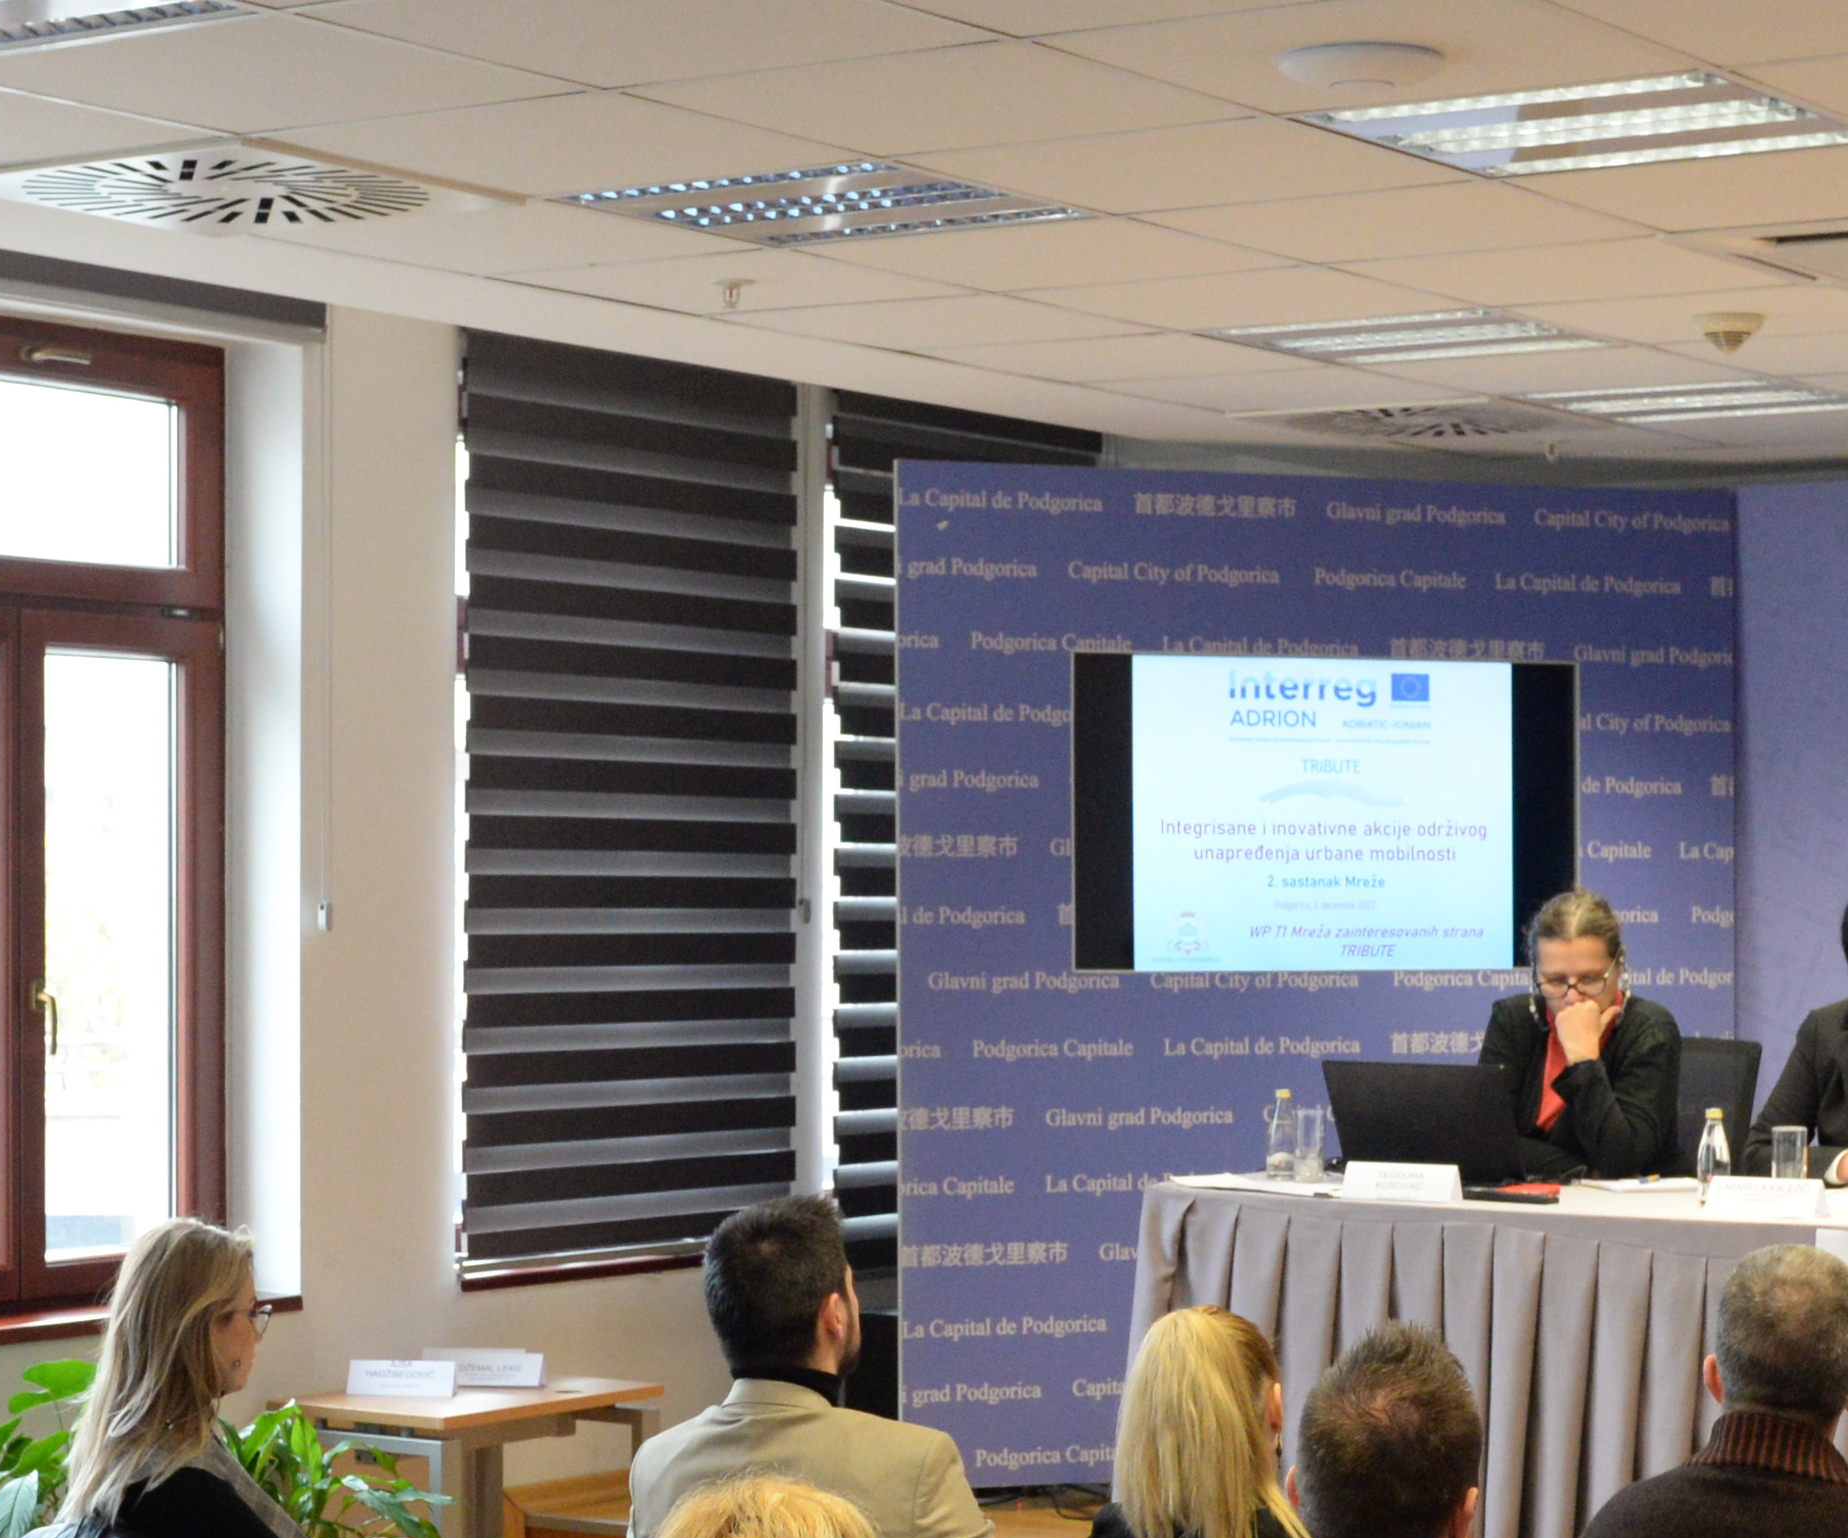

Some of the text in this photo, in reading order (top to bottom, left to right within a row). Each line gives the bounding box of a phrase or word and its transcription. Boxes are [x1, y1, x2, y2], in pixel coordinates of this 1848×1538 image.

[897, 487, 1103, 515] La Capital de Podgorica
[1326, 501, 1506, 527] Glavni grad Podgorica
[1534, 508, 1730, 534] Capital City of Podgorica
[907, 557, 1037, 581] grad Podgorica
[1068, 560, 1280, 587] Capital City of Podgorica
[1315, 567, 1466, 592] Podgorica Capitale
[1495, 572, 1681, 597] La Capital de Podgorica
[1229, 669, 1377, 707] Interreg
[1230, 710, 1316, 727] ADRION
[1302, 759, 1361, 774] TRIBUTE
[1160, 820, 1256, 838] Integrisane
[1273, 820, 1357, 836] inovativne
[1363, 821, 1411, 840] akcije
[1417, 820, 1488, 841] održivog
[1194, 845, 1456, 864] unapređenja urbane mobilnosti
[1282, 875, 1341, 888] sastanak
[1345, 875, 1385, 888] Mreže
[1250, 925, 1272, 939] WP
[1290, 924, 1332, 939] Mreža
[1335, 926, 1438, 939] zainteresovanih
[1442, 927, 1484, 939] strana
[1340, 945, 1396, 957] TRIBUTE
[928, 972, 1119, 994] Glavni grad Podgorica
[1150, 971, 1358, 993] Capital City of Podgorica
[973, 1039, 1133, 1062] Podgorica Capitale
[1164, 1036, 1361, 1059] La Capital de Podgorica
[1045, 1107, 1233, 1131] Glavni grad Podgorica
[902, 1315, 1107, 1341] La Capital de Podgorica
[912, 1382, 1042, 1408] grad Podgorica
